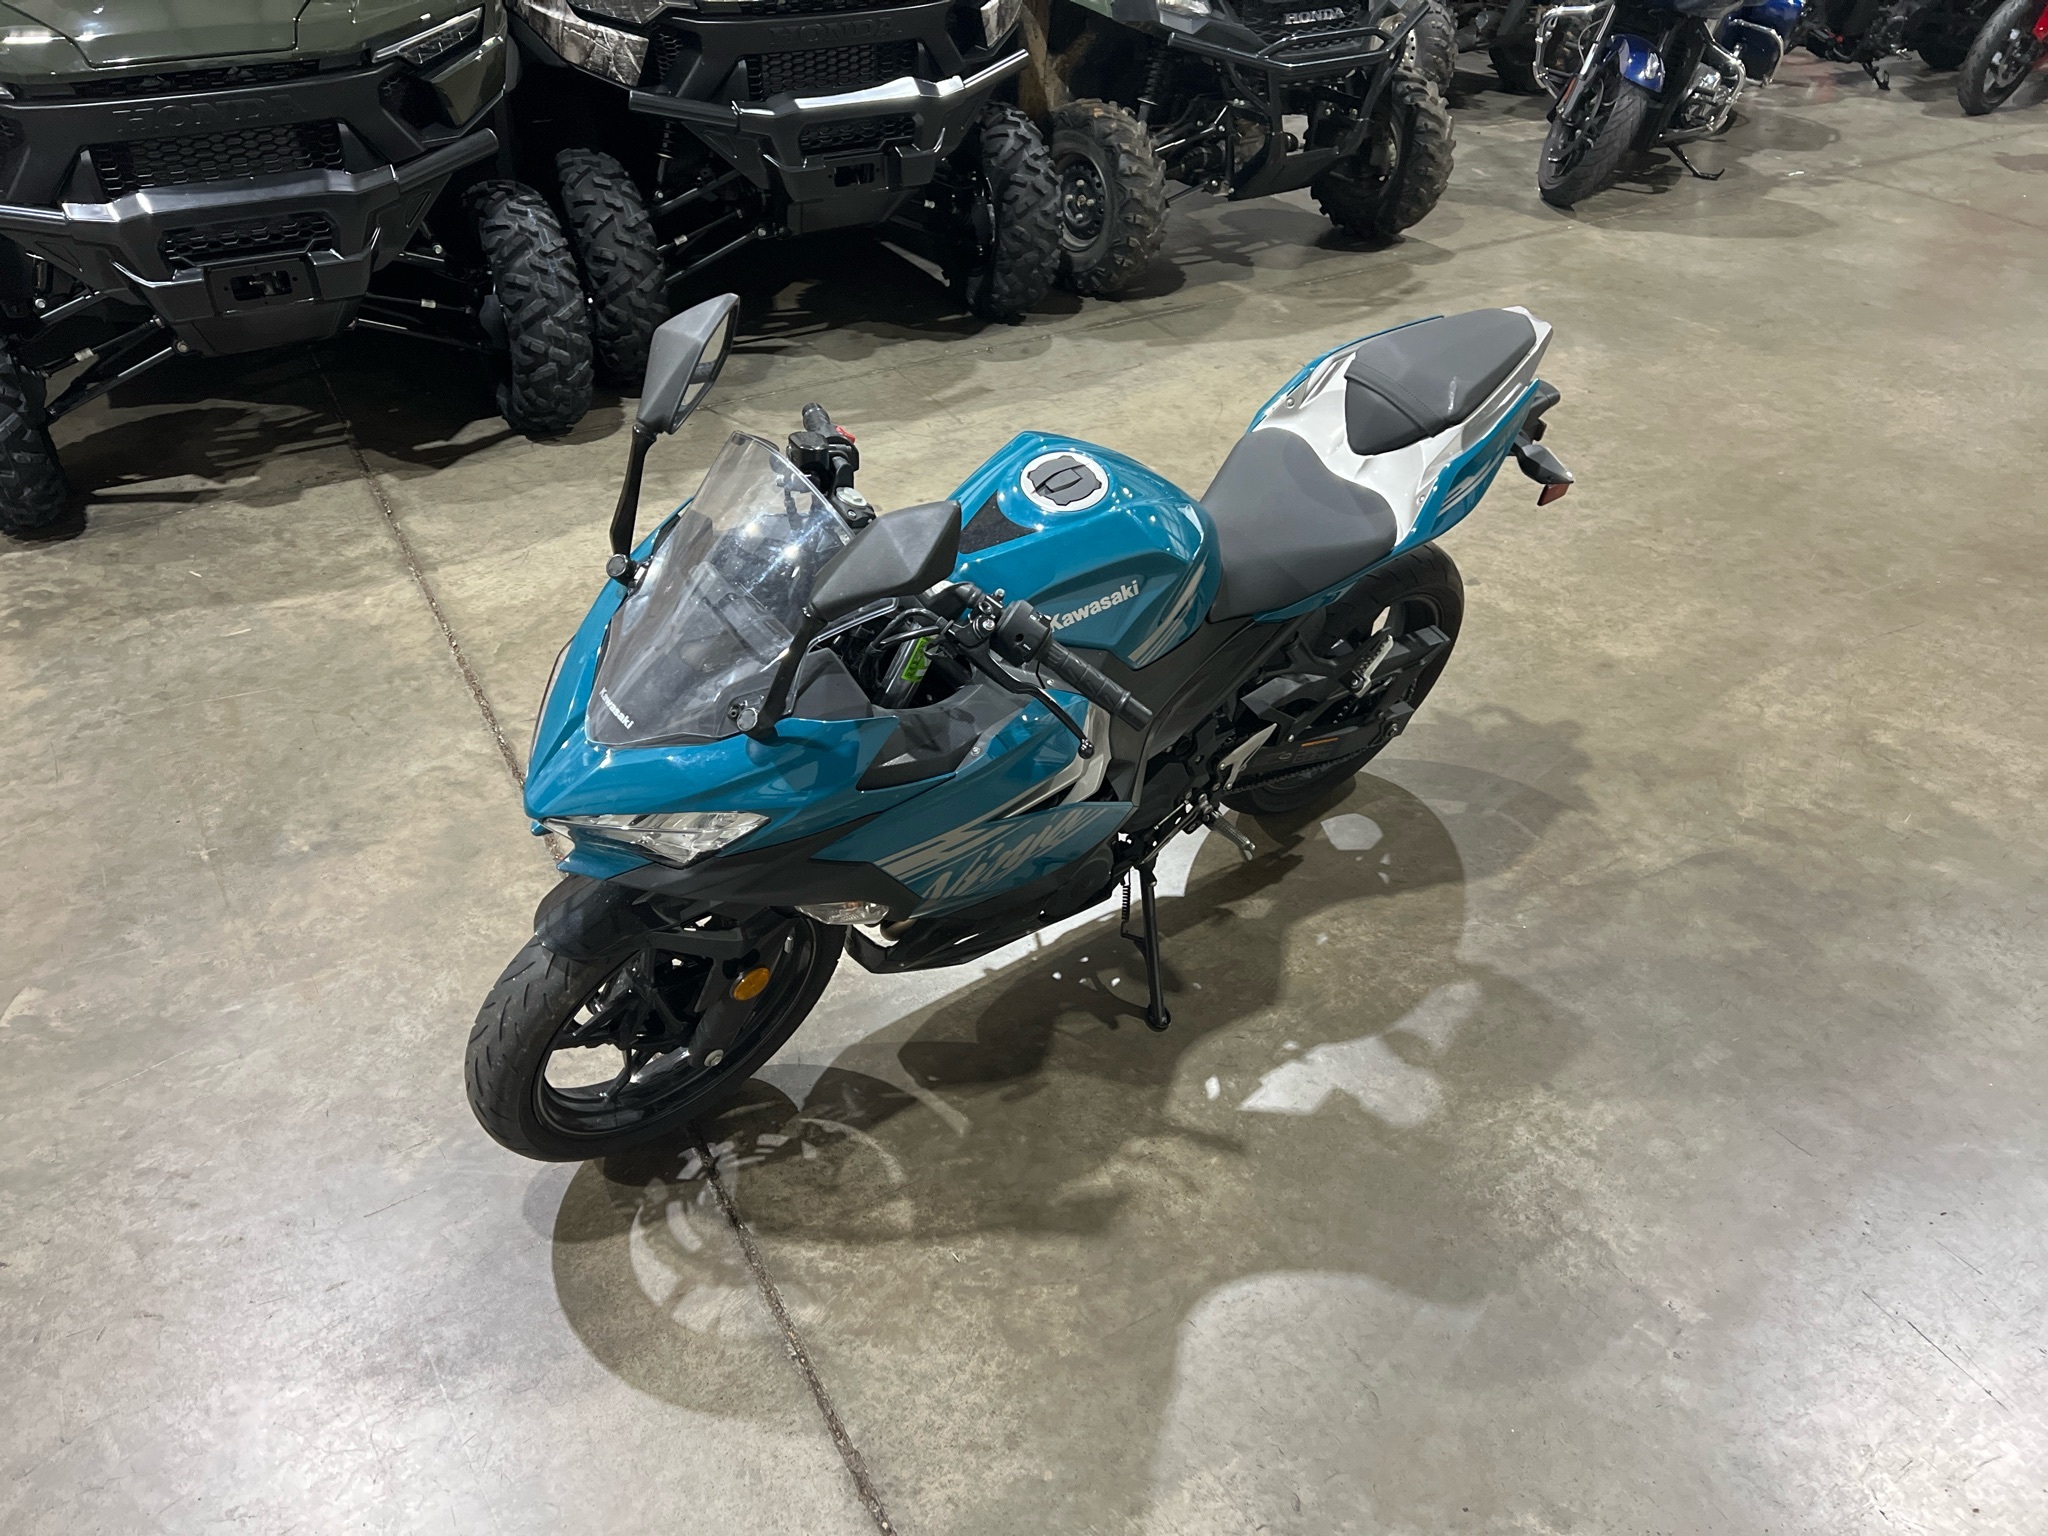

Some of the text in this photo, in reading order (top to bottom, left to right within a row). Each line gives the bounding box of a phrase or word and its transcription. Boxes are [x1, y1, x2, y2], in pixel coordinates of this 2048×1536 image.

[769, 17, 902, 45] HONDA
[1283, 7, 1346, 25] HONDA
[112, 94, 305, 132] HONDA
[1050, 579, 1140, 633] Kawasaki
[599, 686, 635, 730] Kawasaki
